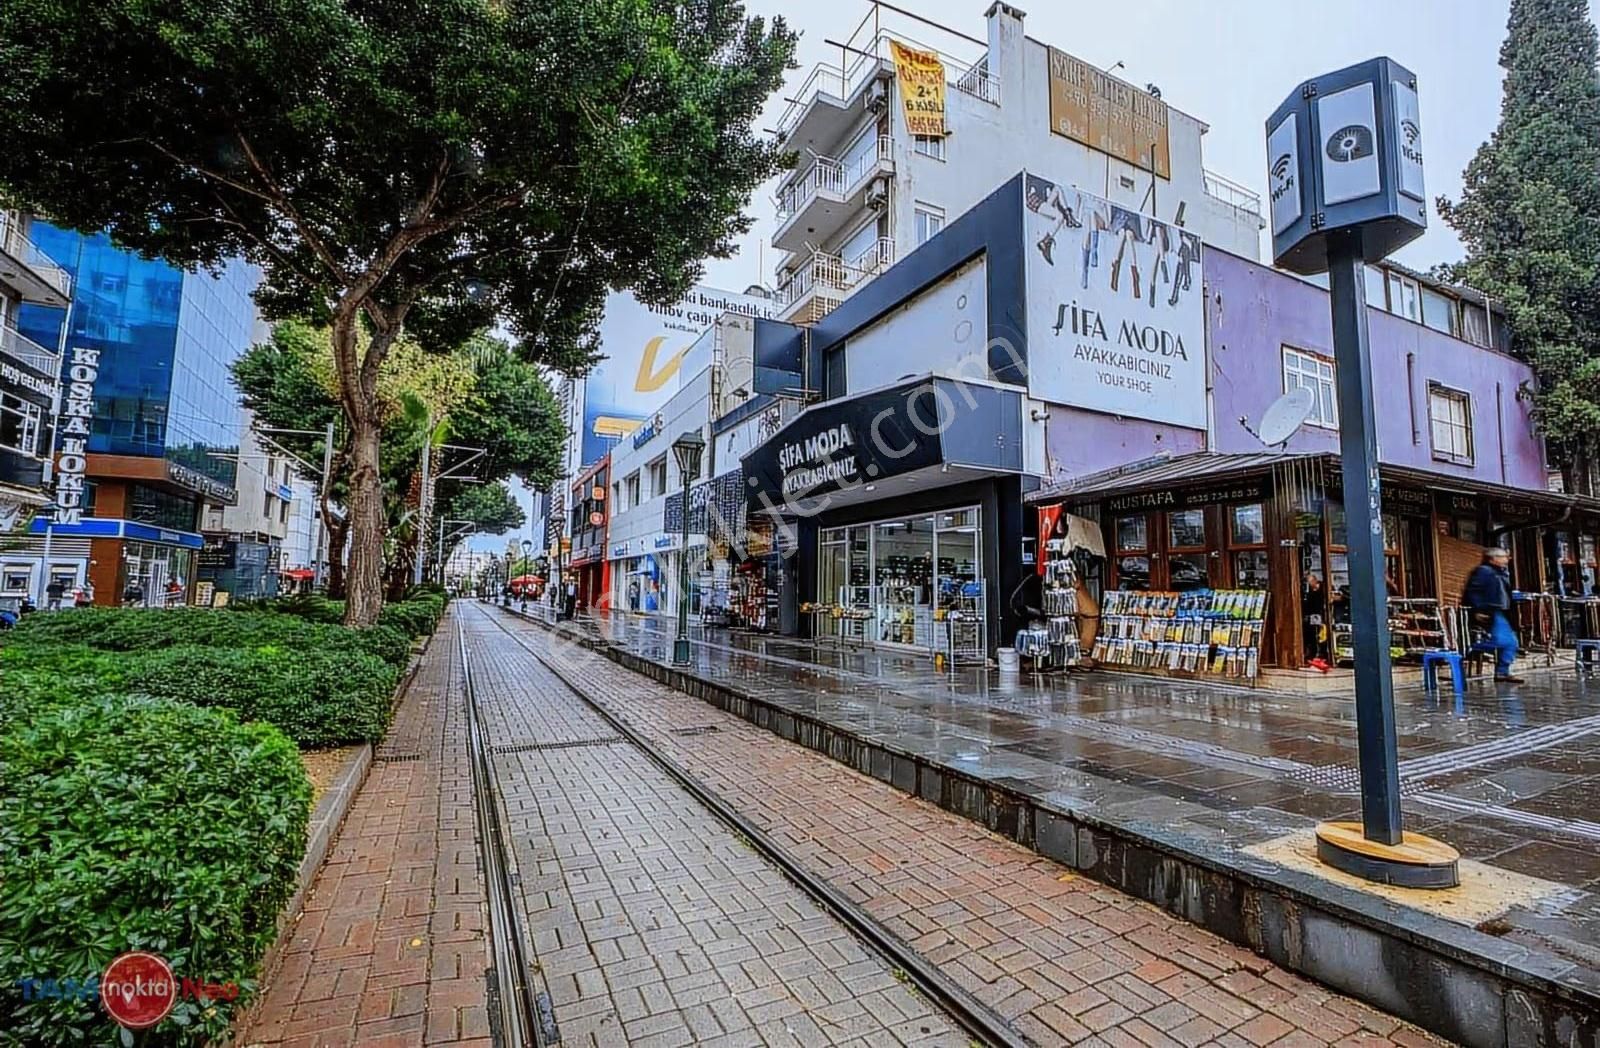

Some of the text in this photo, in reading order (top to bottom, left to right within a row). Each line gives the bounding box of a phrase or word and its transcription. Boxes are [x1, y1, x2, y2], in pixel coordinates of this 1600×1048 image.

[917, 85, 939, 99] 2+1
[687, 311, 712, 326] çağı
[1052, 299, 1188, 361] ŞİFA MODA
[1073, 343, 1172, 379] AYAKKABICINIZ
[1098, 371, 1153, 393] YOUR SHOE
[51, 347, 100, 526] KOSKA LOKUM
[779, 423, 855, 476] ŞİFA MODA
[1109, 491, 1175, 511] MUSTAFA
